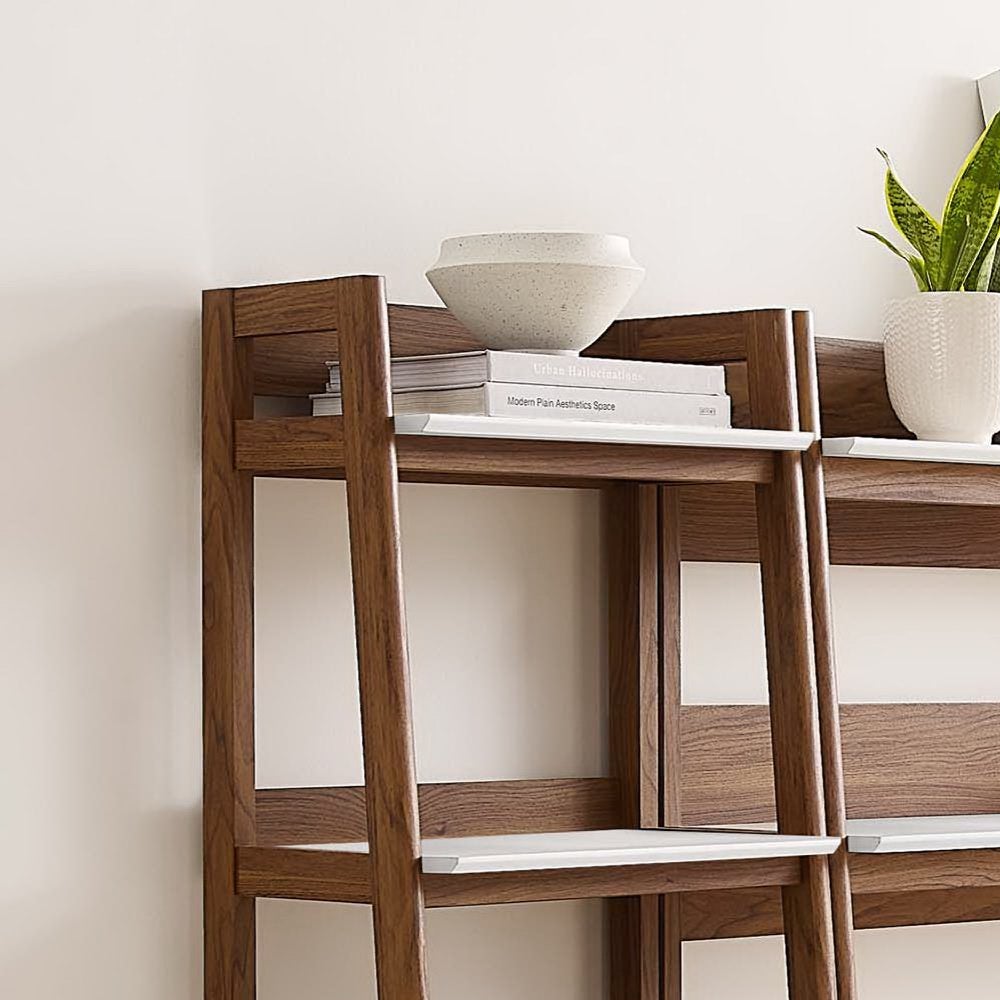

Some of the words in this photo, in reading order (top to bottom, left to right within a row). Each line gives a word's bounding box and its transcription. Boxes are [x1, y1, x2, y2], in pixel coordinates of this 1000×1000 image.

[533, 363, 565, 376] Urban
[507, 396, 535, 407] Modern
[537, 397, 554, 408] Plain
[555, 399, 592, 410] Aesthetics
[593, 400, 615, 411] Space
